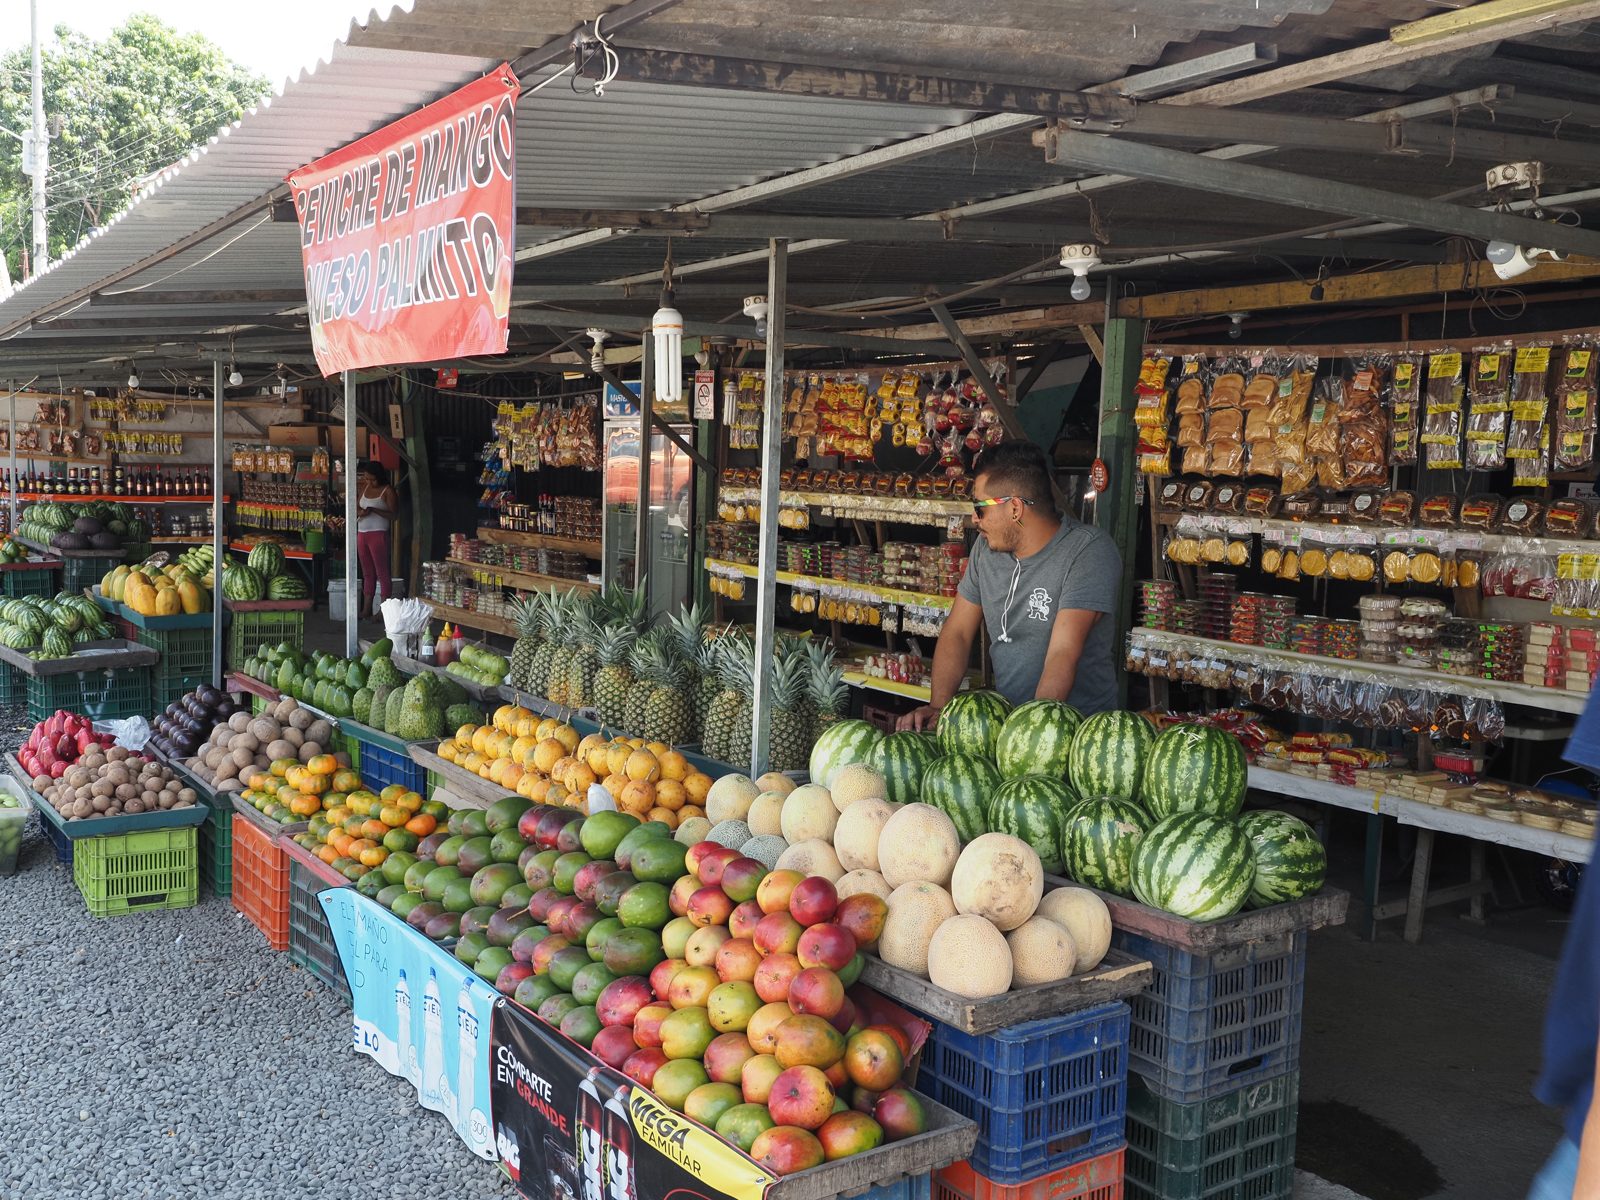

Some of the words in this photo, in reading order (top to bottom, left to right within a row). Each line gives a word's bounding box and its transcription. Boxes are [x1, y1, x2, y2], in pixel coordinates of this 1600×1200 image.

[380, 142, 416, 222] DE
[415, 94, 514, 206] MANGO
[370, 212, 500, 313] PALMITO
[424, 1001, 441, 1017] CIEL
[458, 1014, 479, 1040] CIELO
[497, 1045, 553, 1104] COMPARTE
[497, 1064, 514, 1089] EN
[516, 1078, 571, 1138] GRANDE.
[632, 1096, 691, 1150] MEGA
[642, 1125, 702, 1177] FAMILIAR
